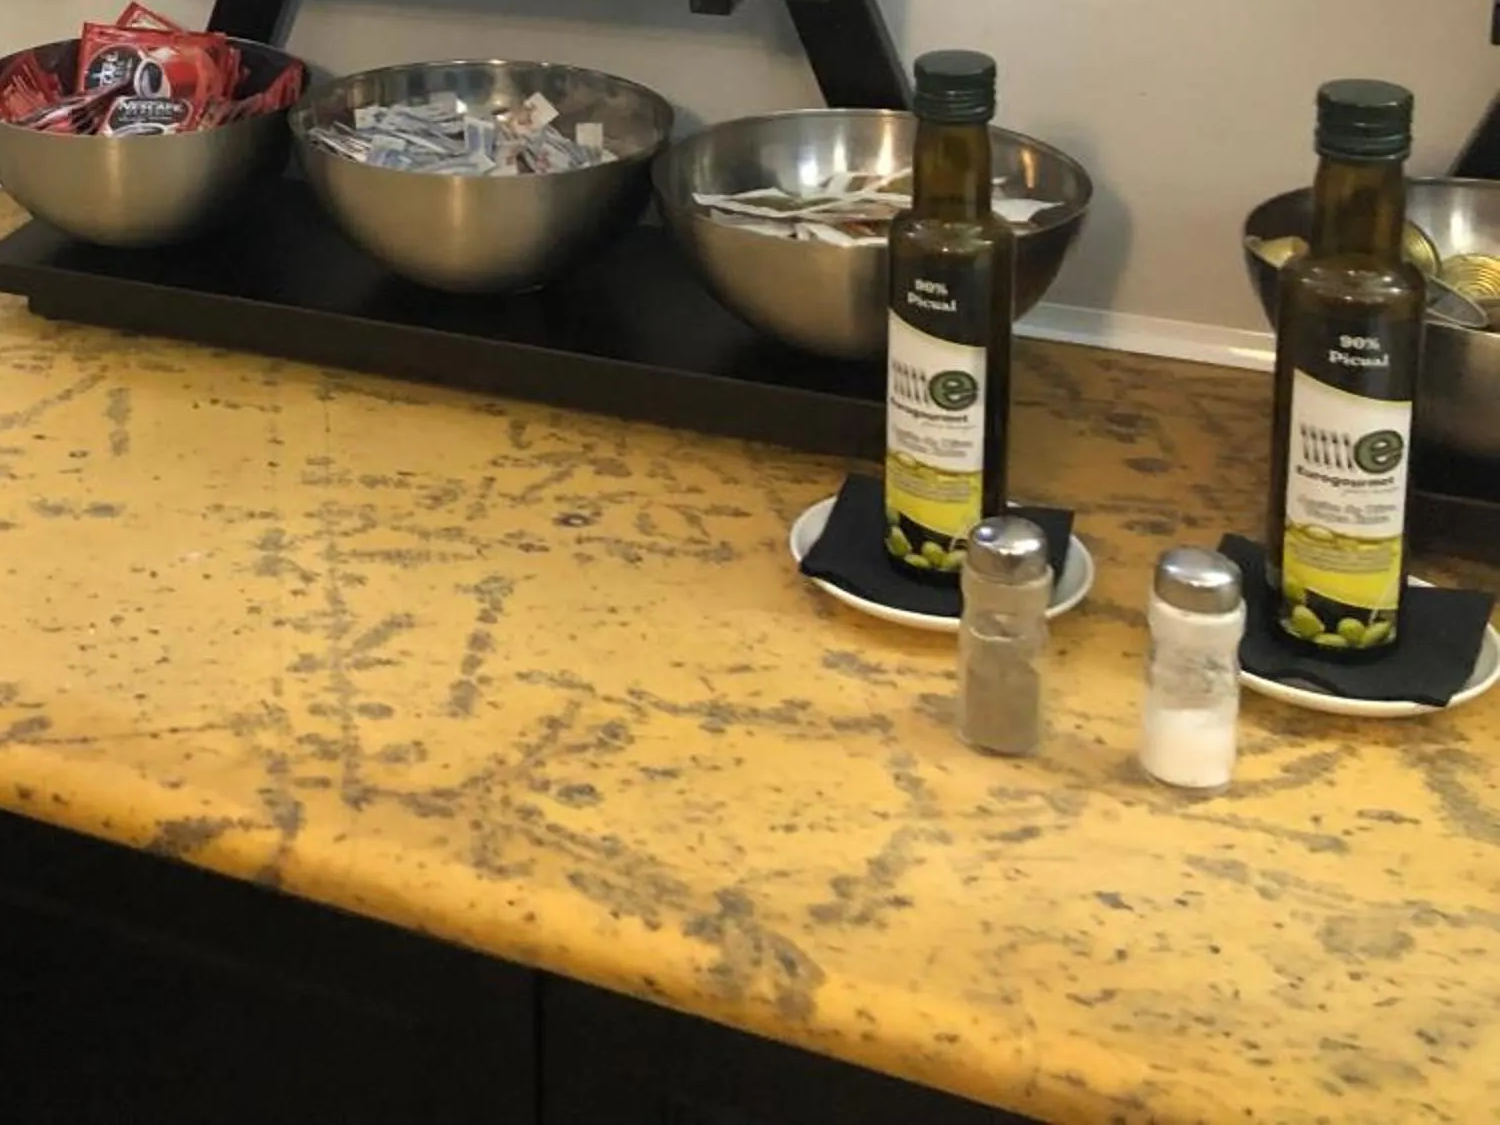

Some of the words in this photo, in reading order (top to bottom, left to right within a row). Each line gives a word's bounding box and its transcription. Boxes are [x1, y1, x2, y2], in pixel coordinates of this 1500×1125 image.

[914, 277, 949, 295] 90%
[907, 291, 958, 313] Picual
[1338, 333, 1381, 351] 90%
[1328, 350, 1390, 369] Picual
